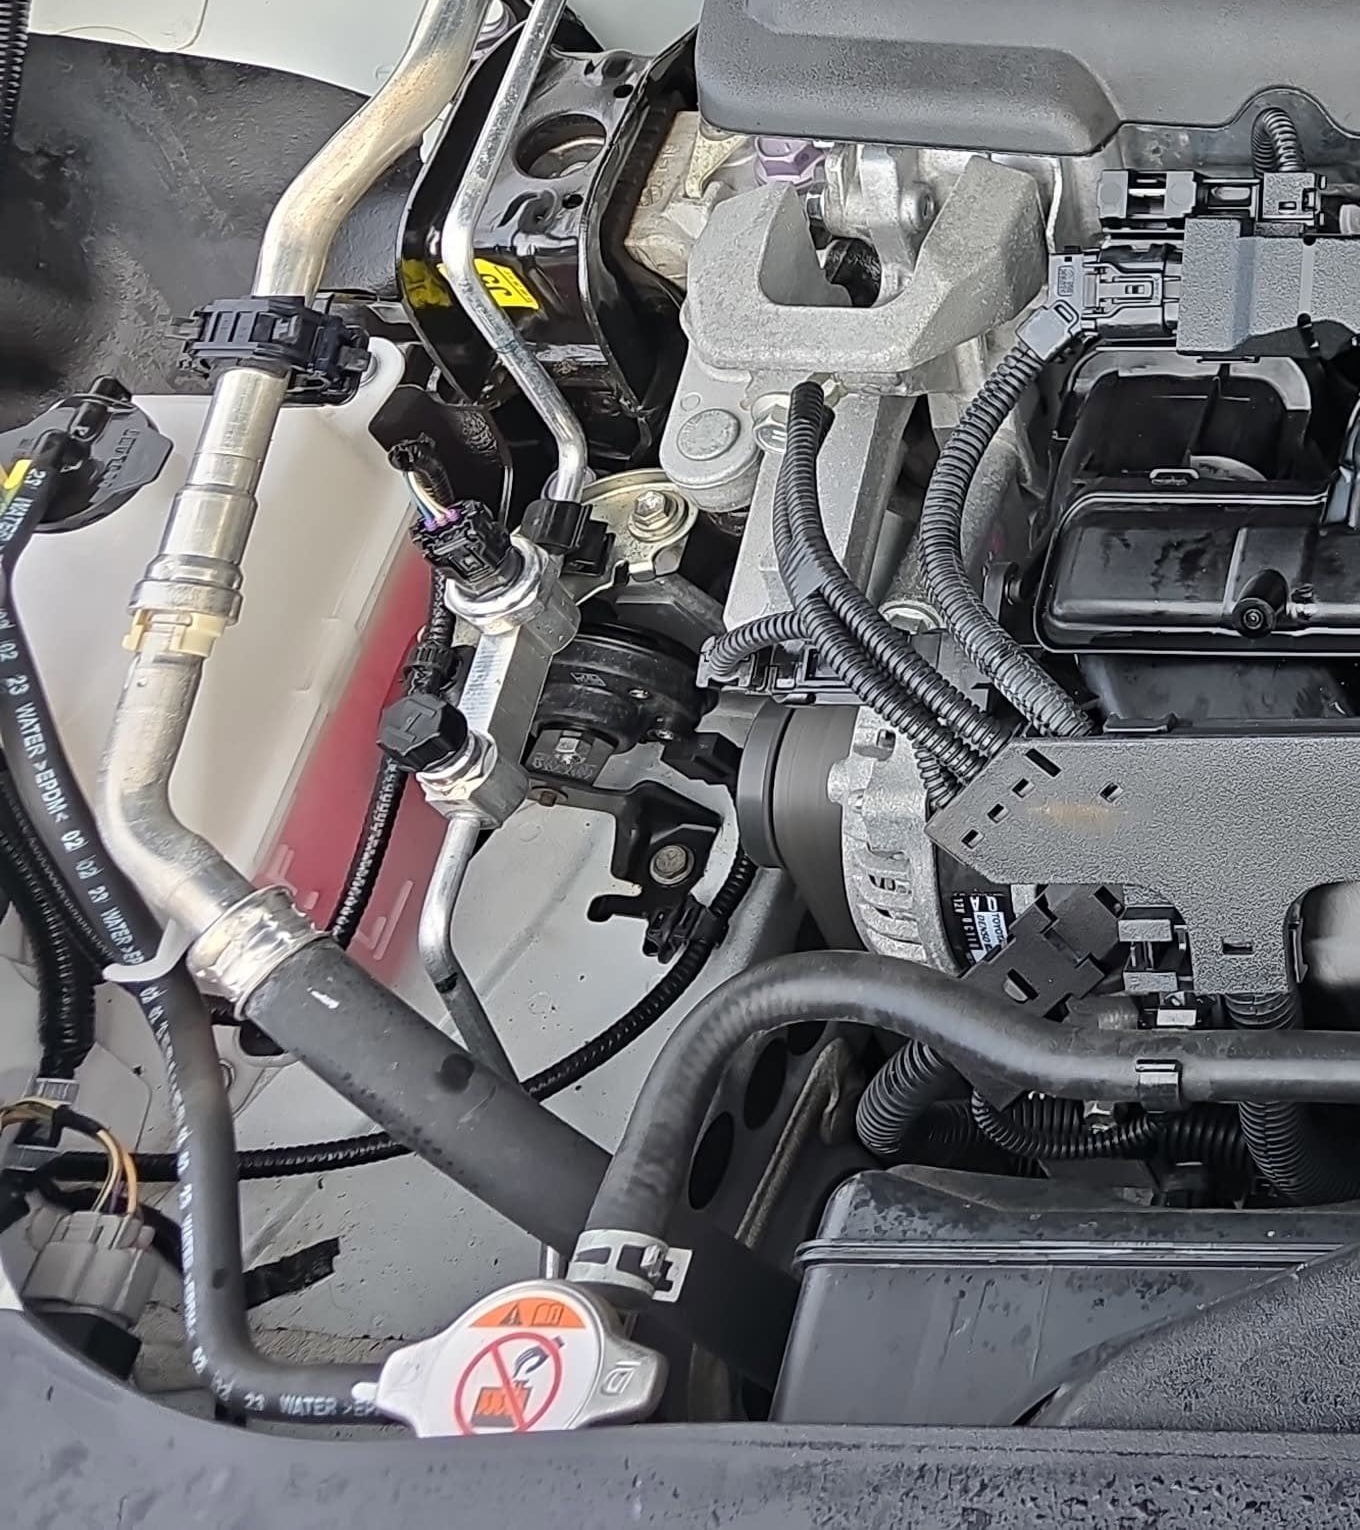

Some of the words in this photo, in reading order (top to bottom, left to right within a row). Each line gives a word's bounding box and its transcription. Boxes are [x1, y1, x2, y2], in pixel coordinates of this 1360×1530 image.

[5, 674, 30, 696] 23
[15, 702, 48, 759] WATER
[34, 759, 71, 823] >EPDM<
[100, 906, 133, 952] WATER
[976, 914, 991, 943] DENSO
[278, 1393, 338, 1418] WATER
